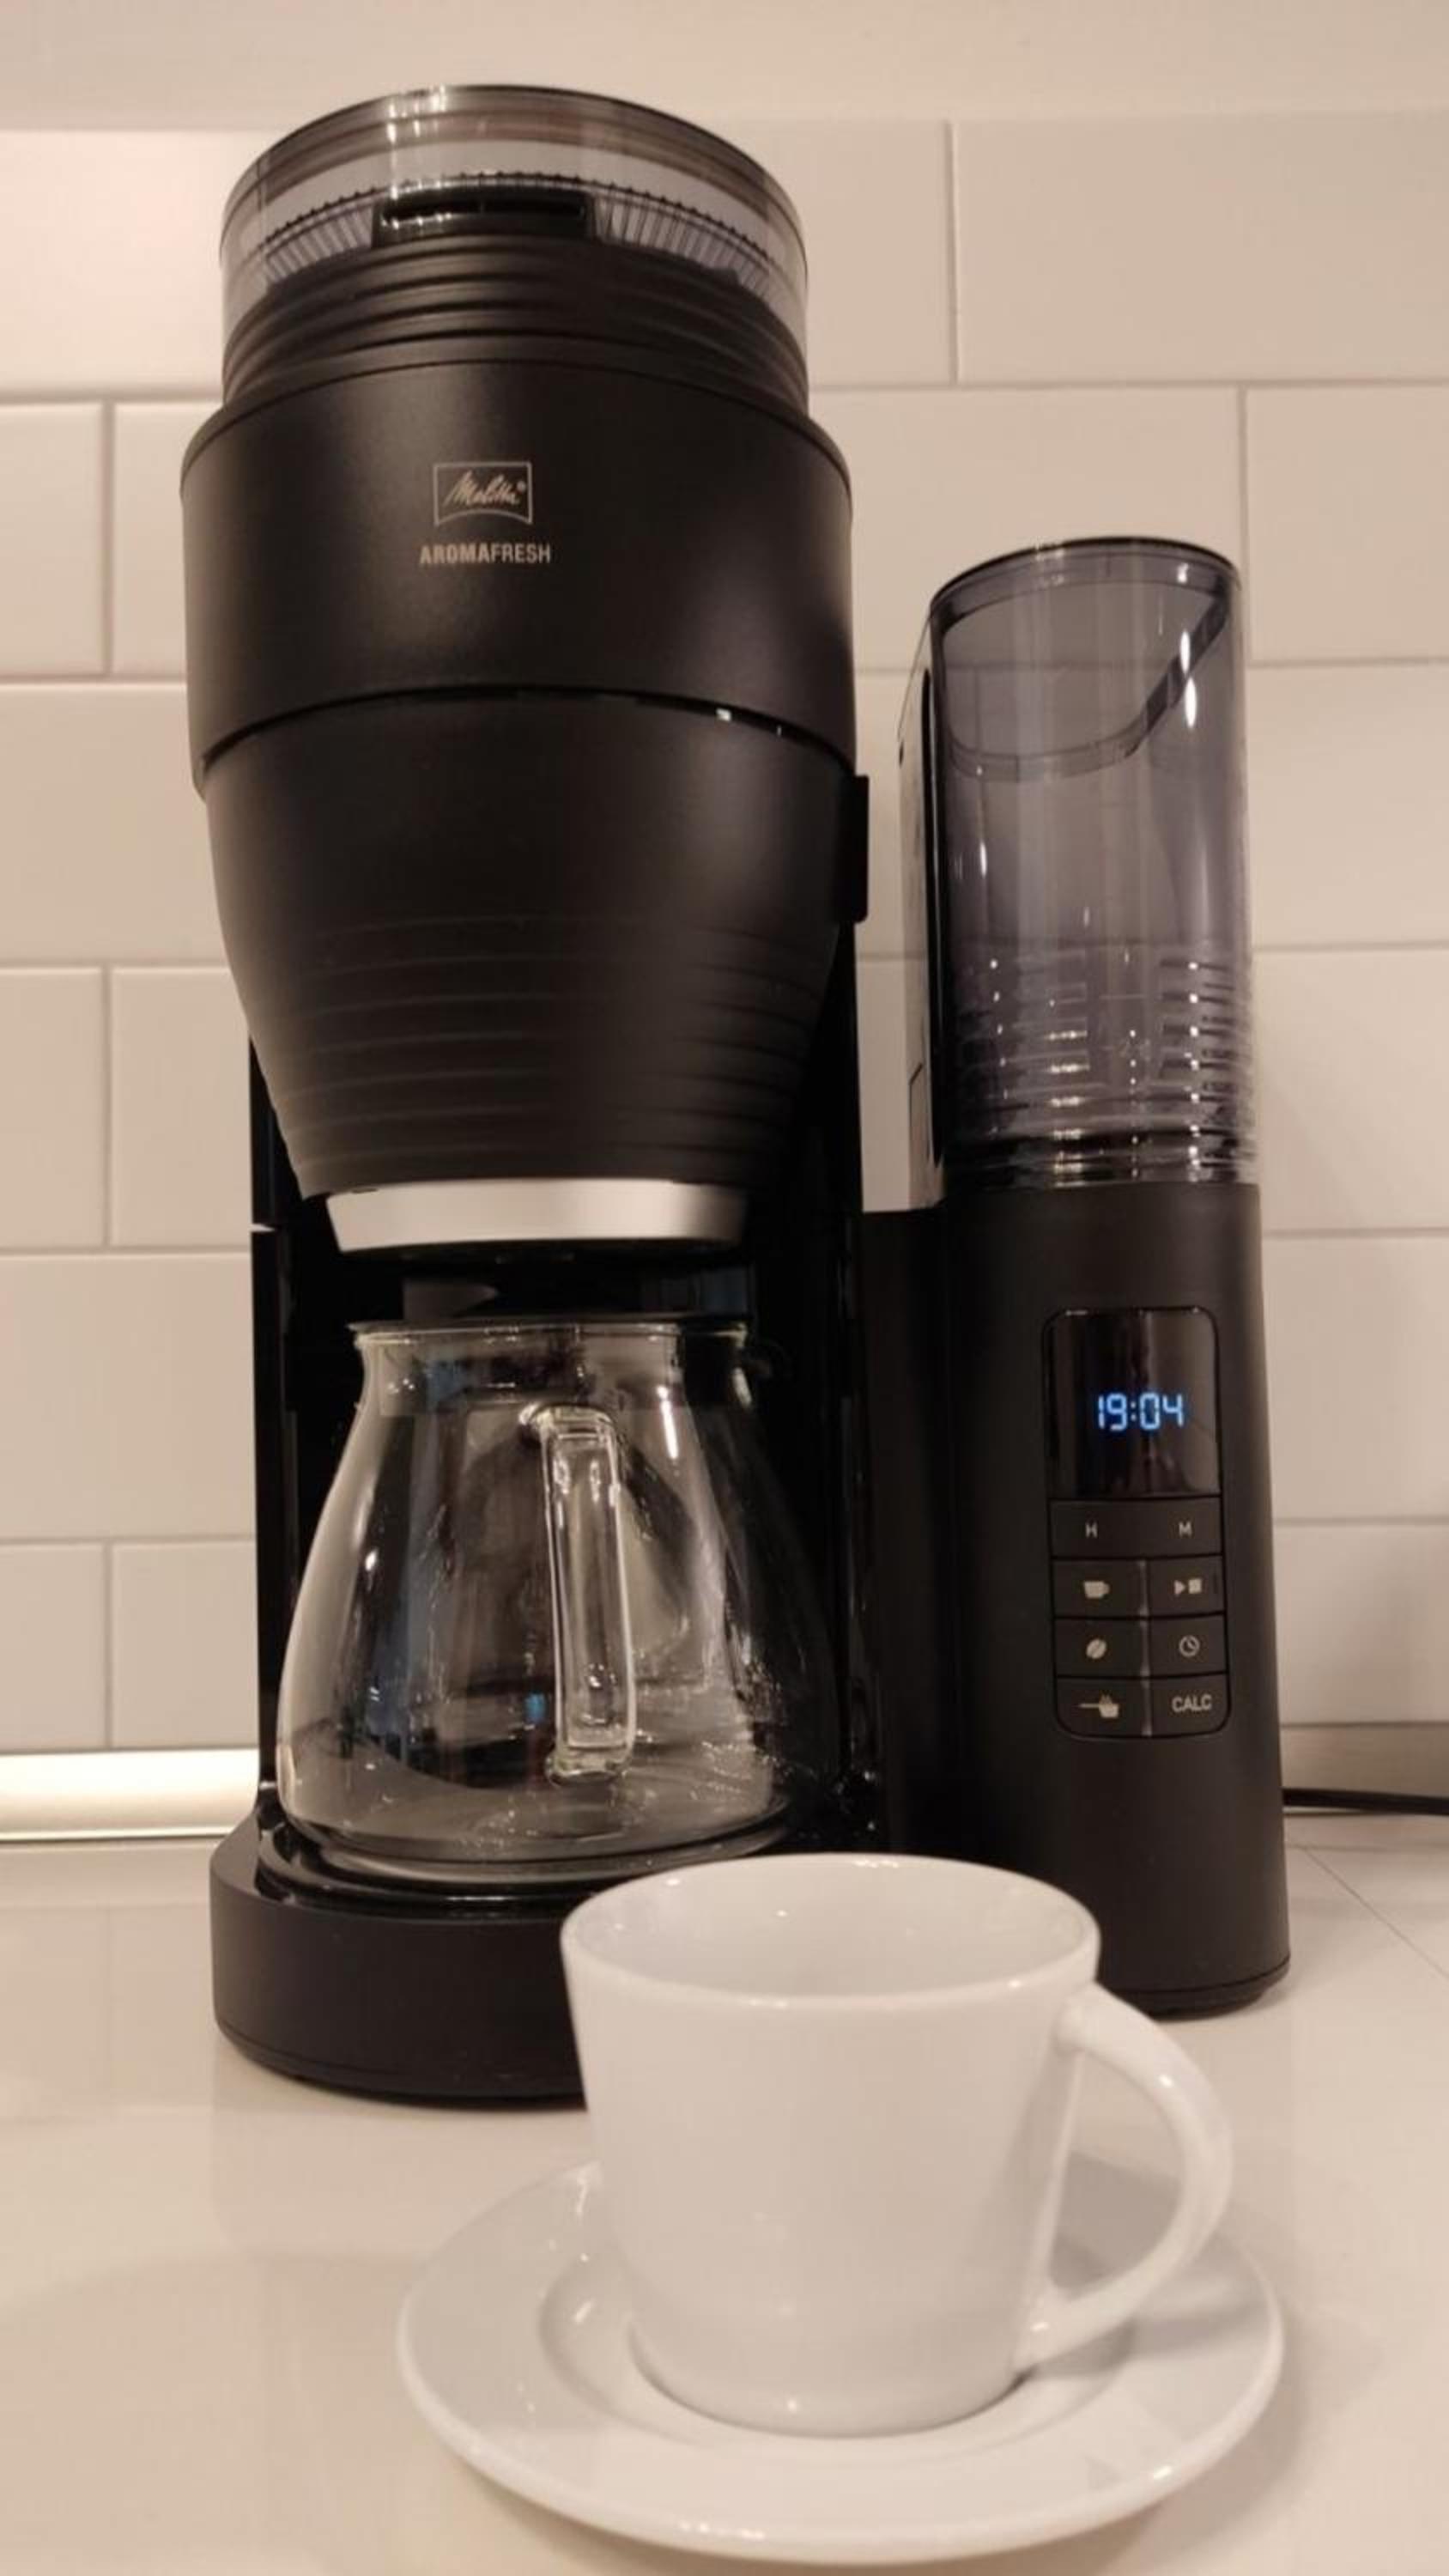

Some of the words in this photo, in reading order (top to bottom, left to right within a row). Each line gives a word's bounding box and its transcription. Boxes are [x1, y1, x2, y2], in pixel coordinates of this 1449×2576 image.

[419, 543, 551, 564] AROMAFRESH
[1098, 1392, 1183, 1431] 19:04
[1085, 1522, 1098, 1539] H
[1179, 1521, 1193, 1537] M
[1172, 1694, 1212, 1713] CALC
